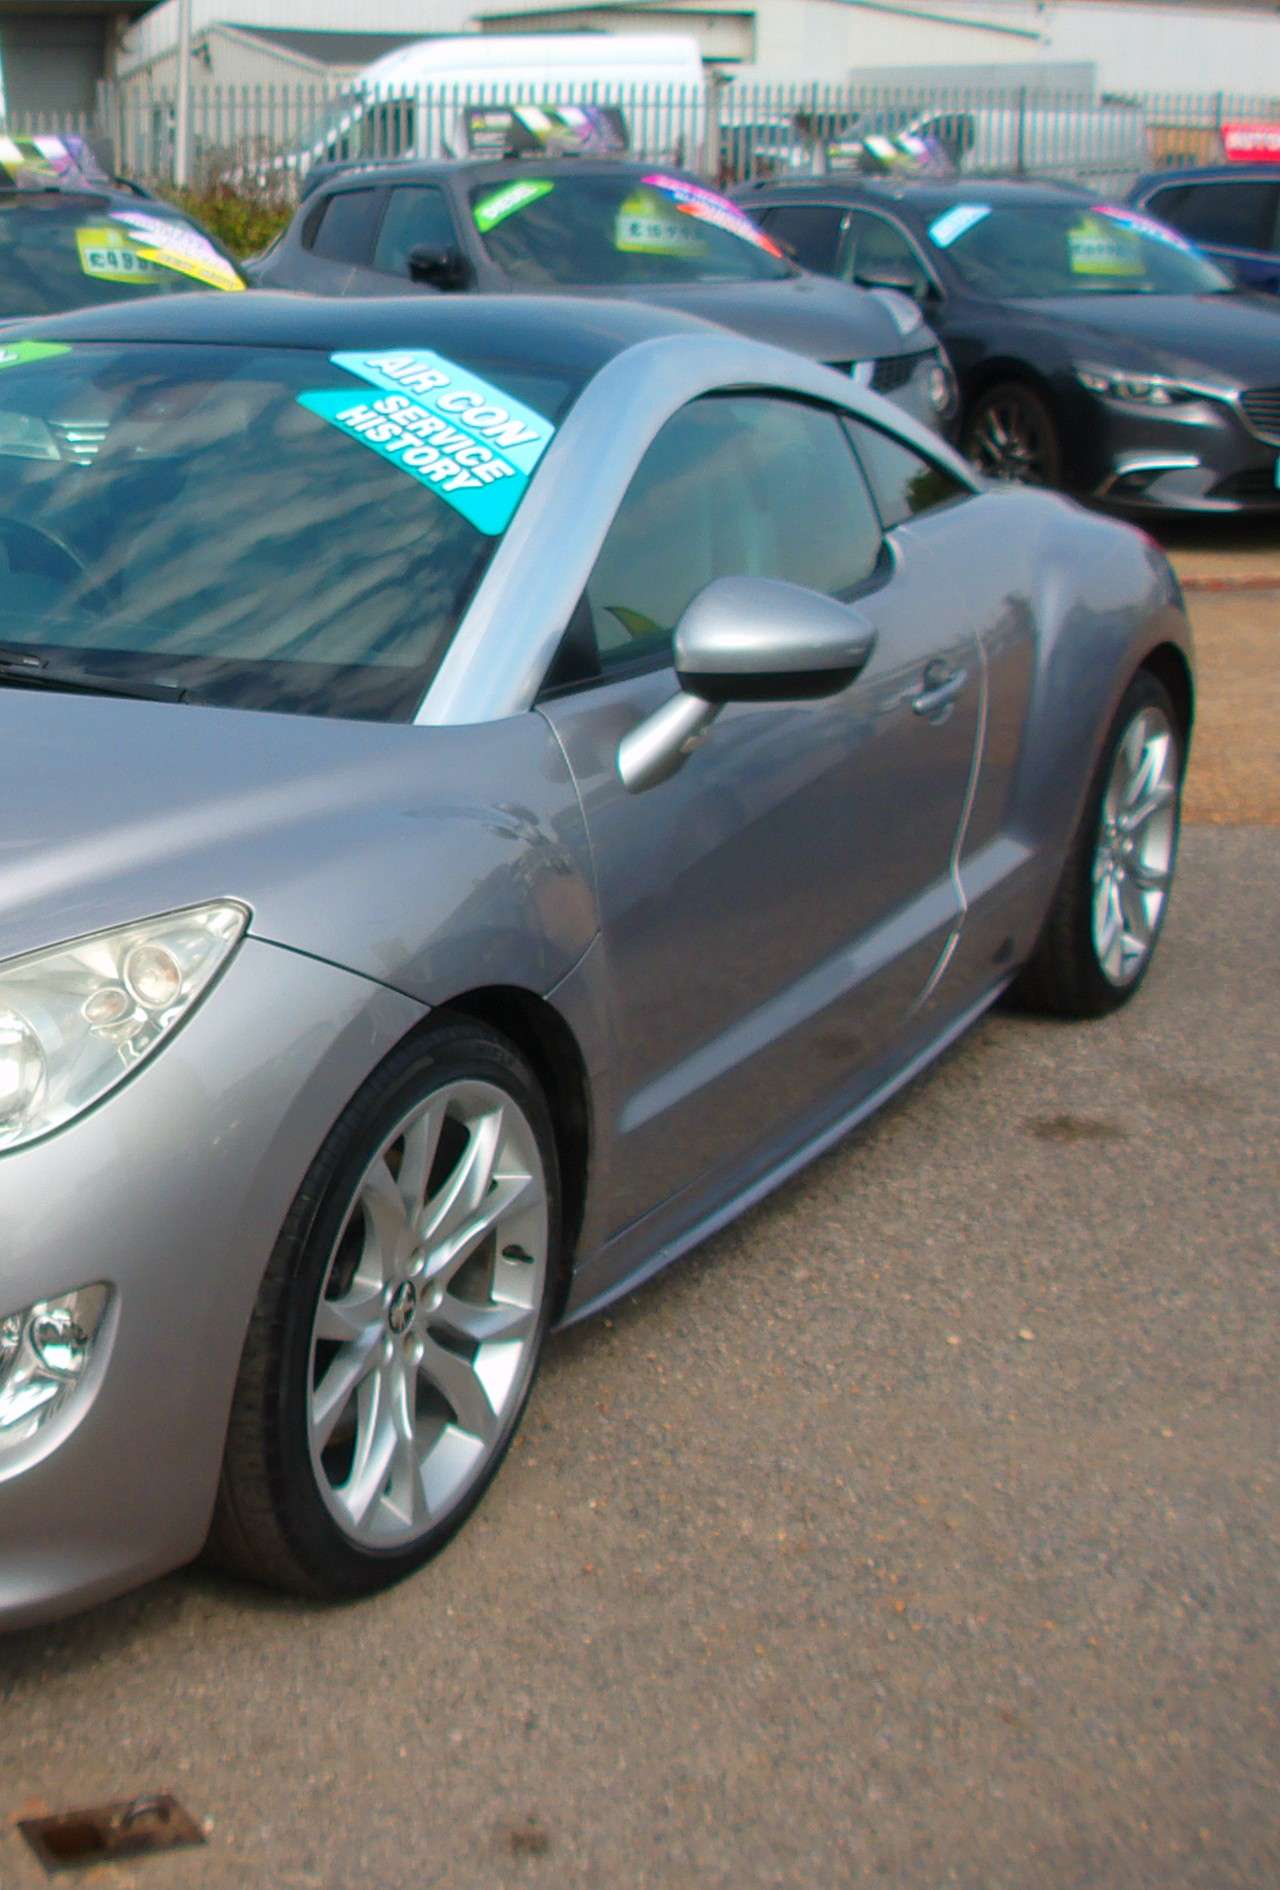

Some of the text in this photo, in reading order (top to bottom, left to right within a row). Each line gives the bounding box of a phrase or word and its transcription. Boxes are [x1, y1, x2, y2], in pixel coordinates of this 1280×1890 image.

[363, 355, 541, 450] AIR CON
[371, 394, 517, 484] SERVICE
[334, 403, 486, 493] HISTORY
